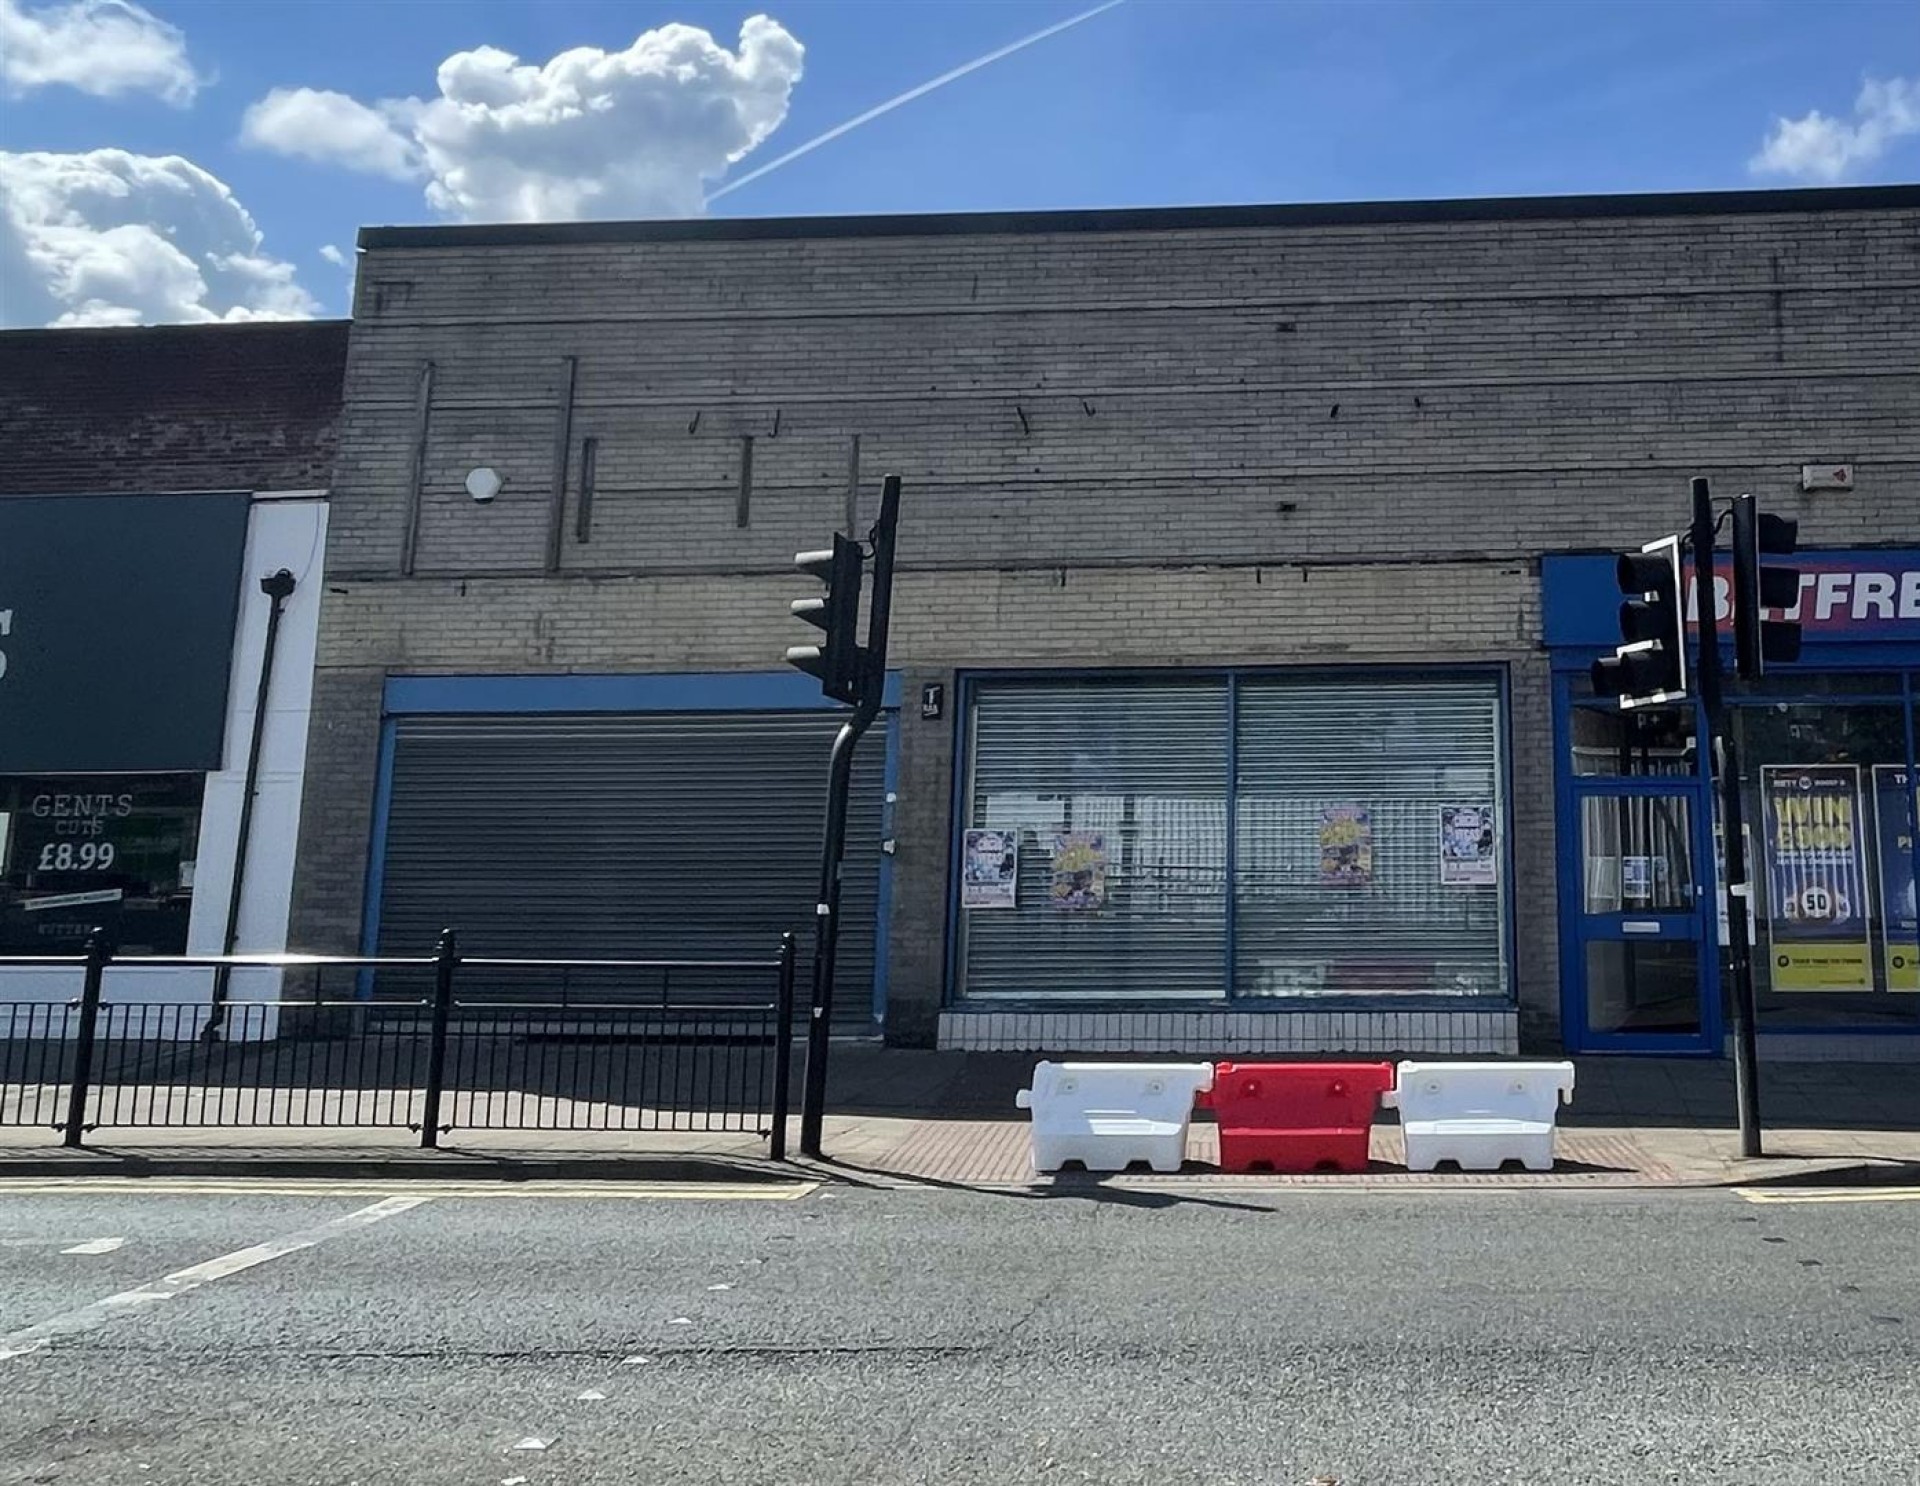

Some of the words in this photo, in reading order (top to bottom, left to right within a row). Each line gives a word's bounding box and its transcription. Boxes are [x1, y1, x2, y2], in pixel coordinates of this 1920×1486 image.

[32, 794, 133, 817] GENTS
[1774, 797, 1850, 824] WIN
[55, 819, 104, 835] CUTS
[37, 842, 115, 871] £8.99
